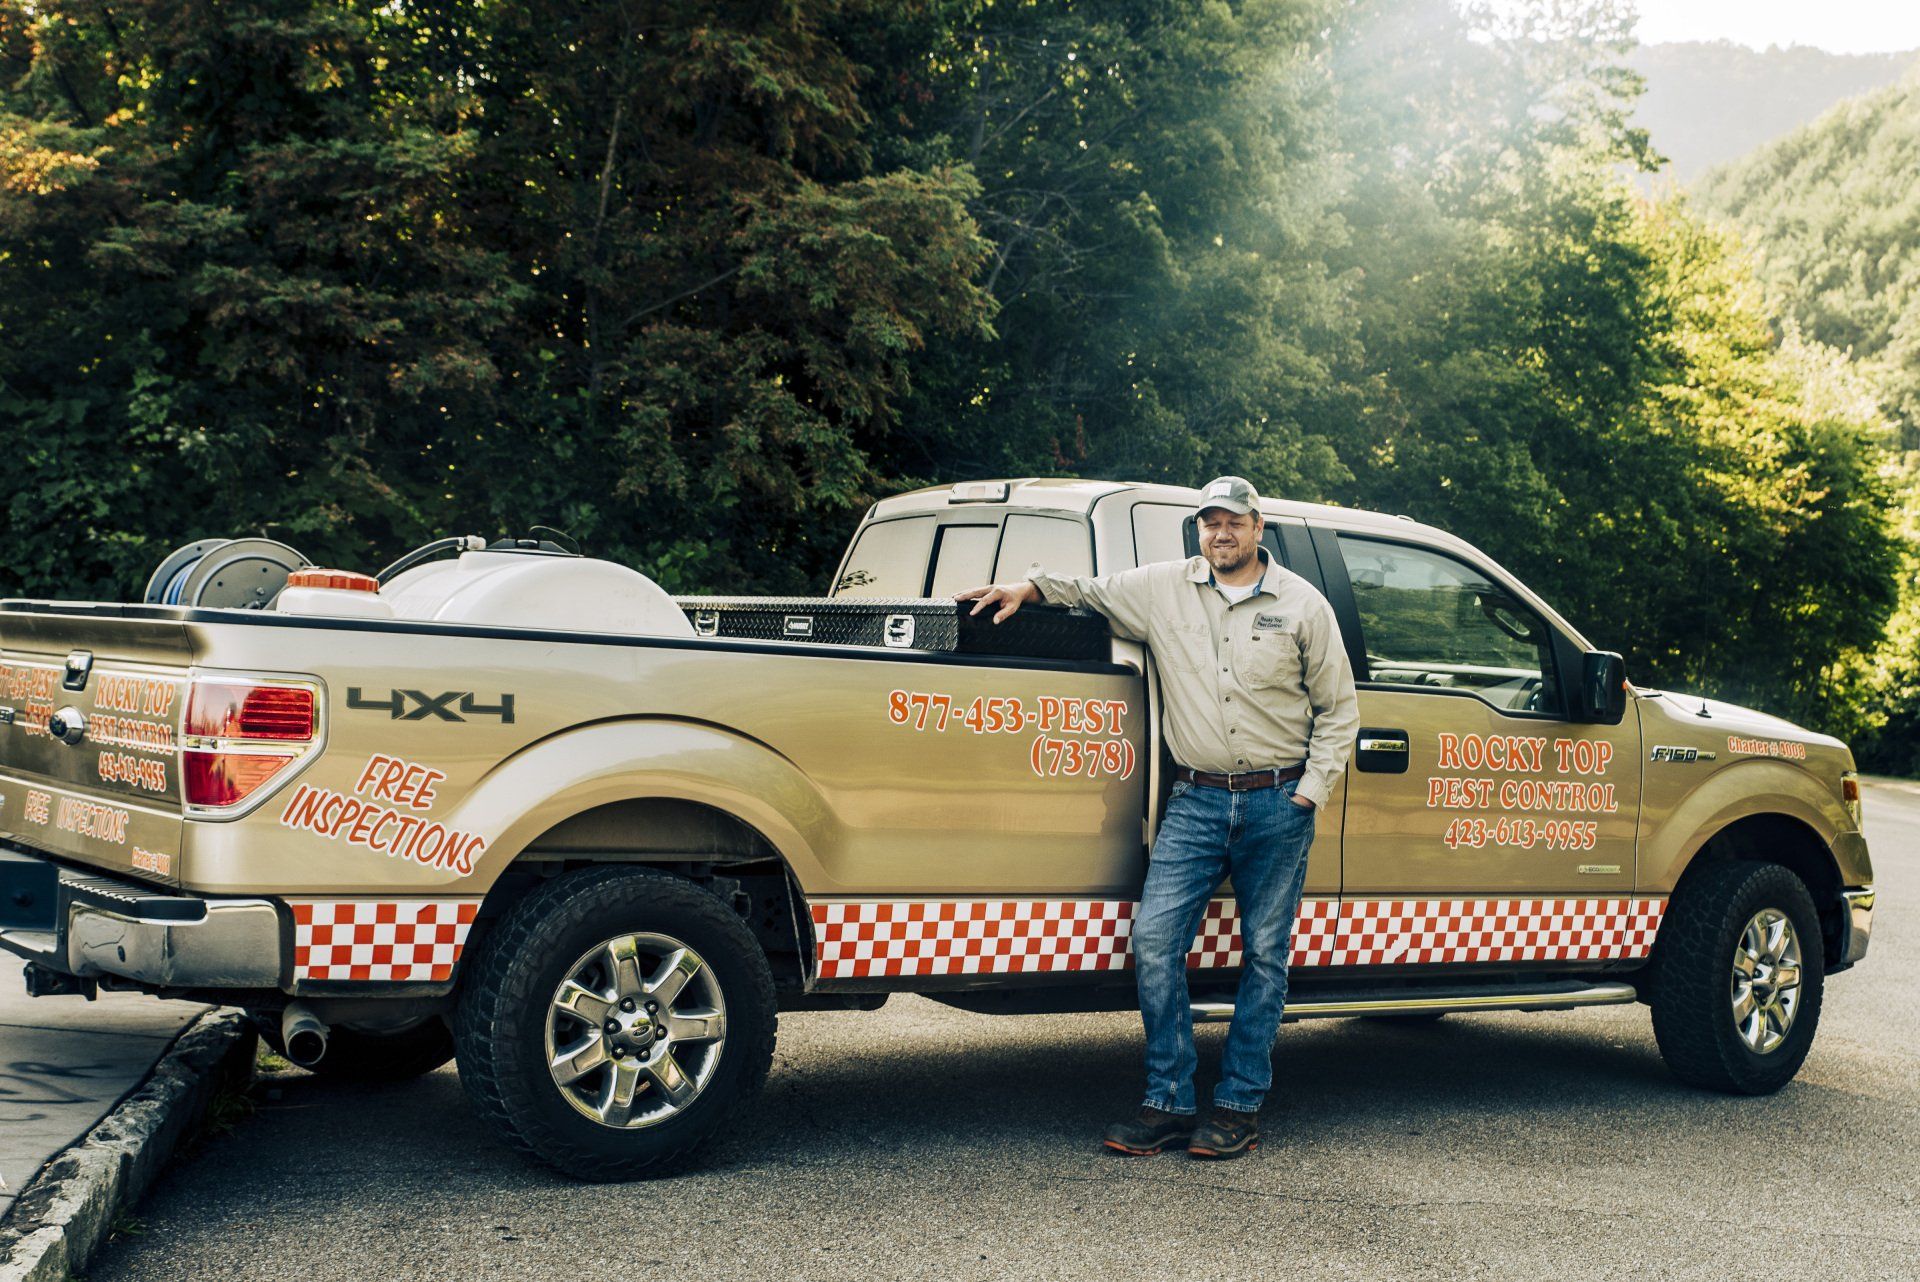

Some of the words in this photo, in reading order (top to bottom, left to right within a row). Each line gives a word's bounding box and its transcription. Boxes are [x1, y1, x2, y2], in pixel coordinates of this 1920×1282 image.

[95, 676, 144, 713] ROCKY
[142, 681, 174, 717] TOP
[888, 689, 1128, 735] 877-453-PEST
[89, 713, 117, 745] PEST
[117, 717, 173, 756] CONTROL
[1438, 733, 1547, 773] ROCKY
[1554, 738, 1613, 775] TOP
[1727, 736, 1769, 756] Charter
[1770, 741, 1779, 757] #
[98, 751, 166, 792] 423-613-9955
[1030, 734, 1136, 780] (7378)
[355, 753, 447, 810] FREE
[1427, 777, 1495, 809] PEST
[1500, 780, 1618, 813] CONTROL
[24, 790, 52, 825] FREE
[57, 797, 130, 844] INSPECTIONS
[280, 783, 487, 877] INSPECTIONS
[1444, 817, 1598, 850] 423-613-9955
